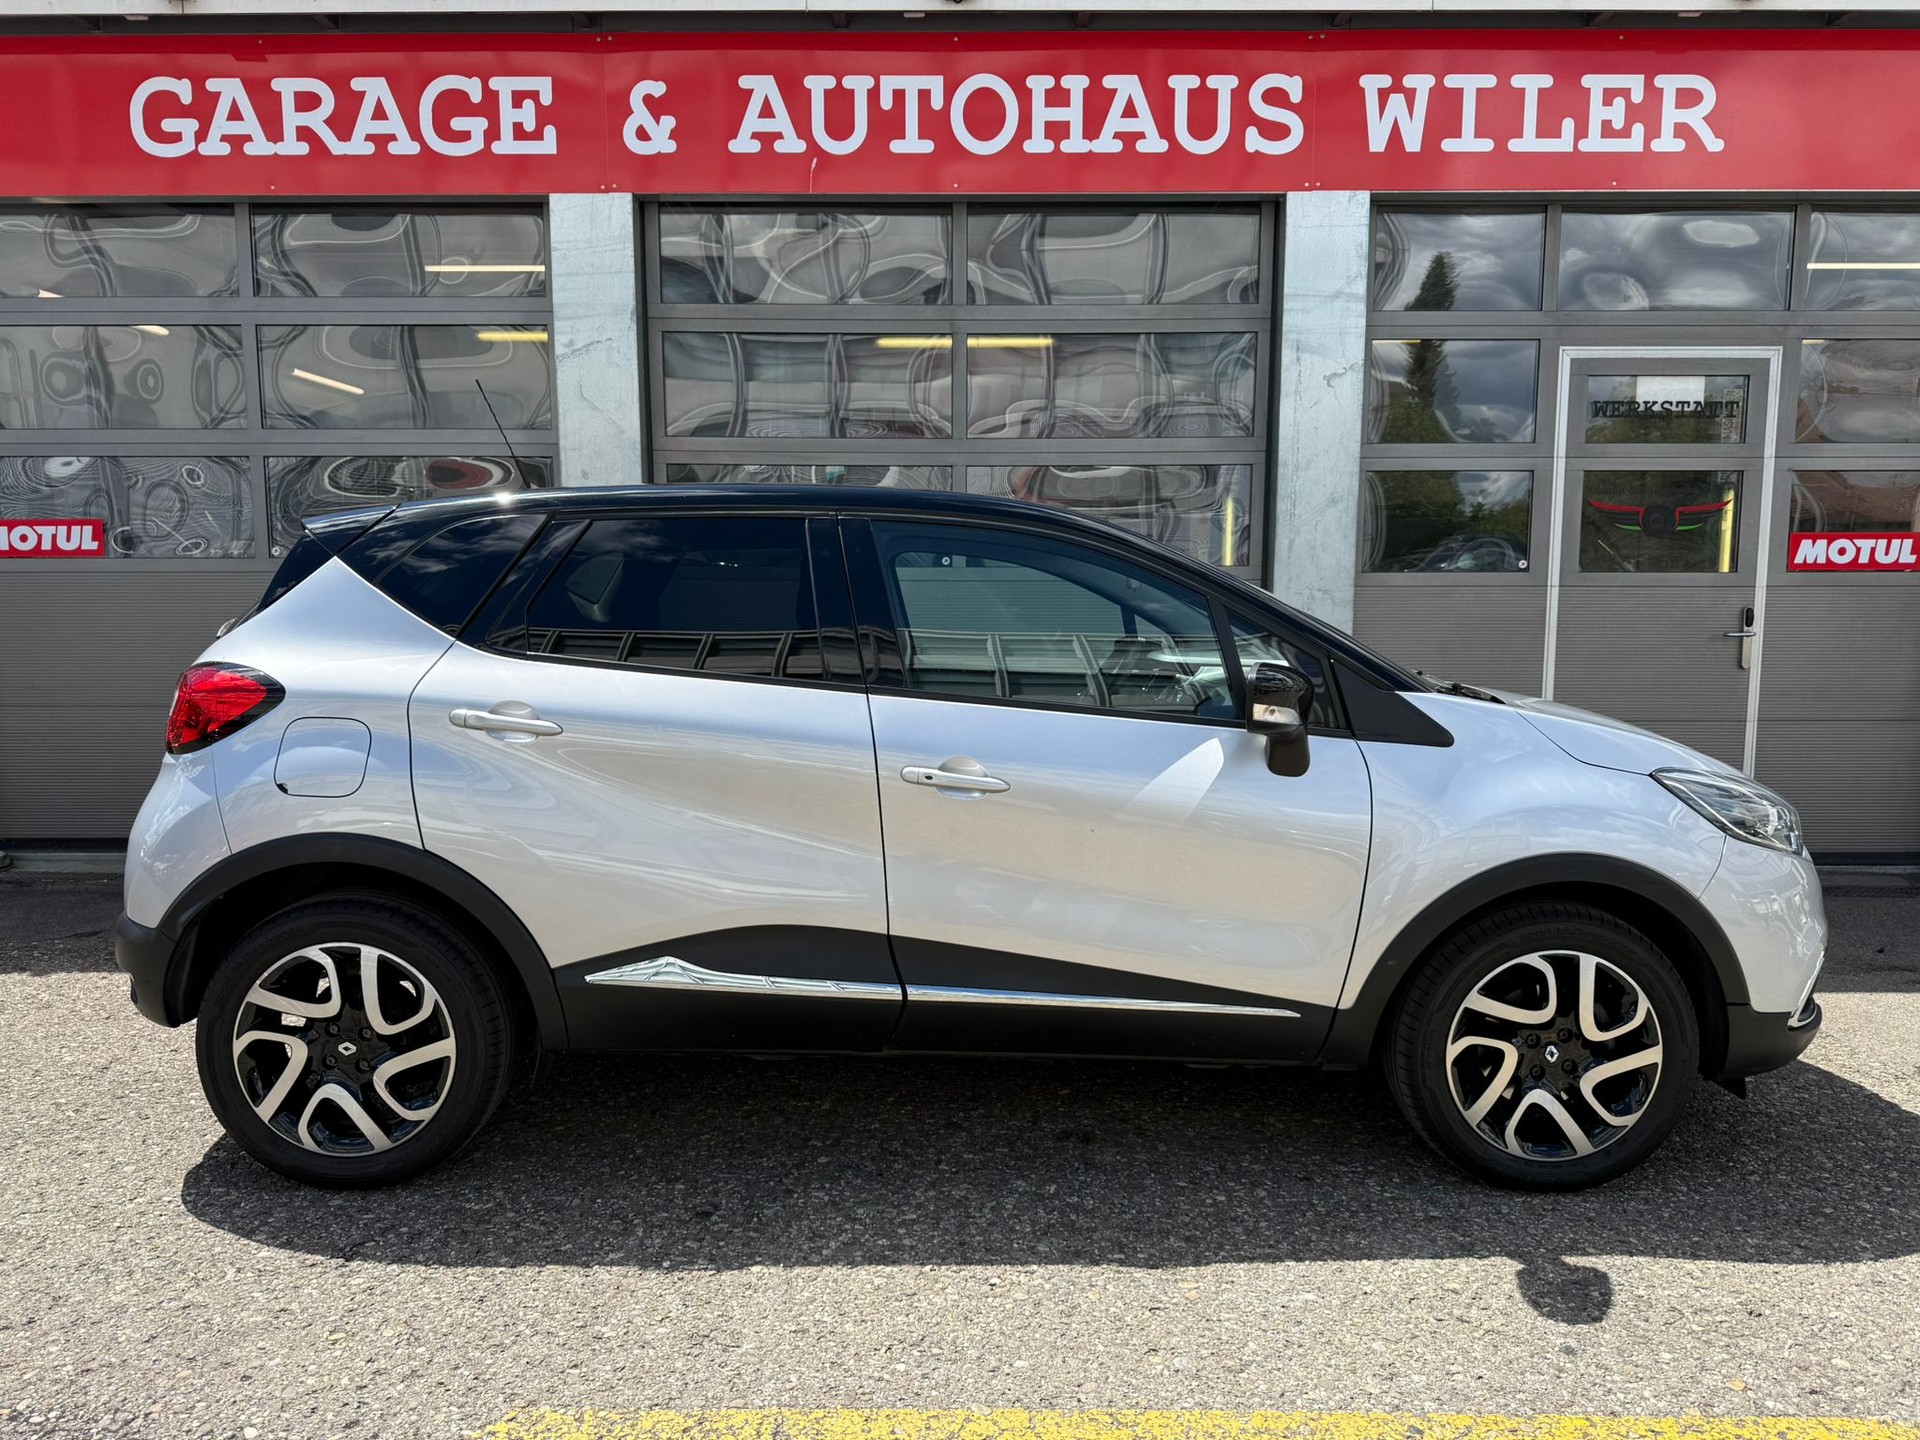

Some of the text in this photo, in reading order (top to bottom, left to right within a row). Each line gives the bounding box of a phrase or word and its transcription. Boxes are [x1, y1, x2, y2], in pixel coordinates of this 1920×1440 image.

[129, 73, 1726, 158] GARAGE & AUTOHAUS WILER
[1589, 400, 1740, 419] WERKSTATT
[0, 525, 100, 551] OTUL
[1793, 538, 1918, 565] MOTUL
